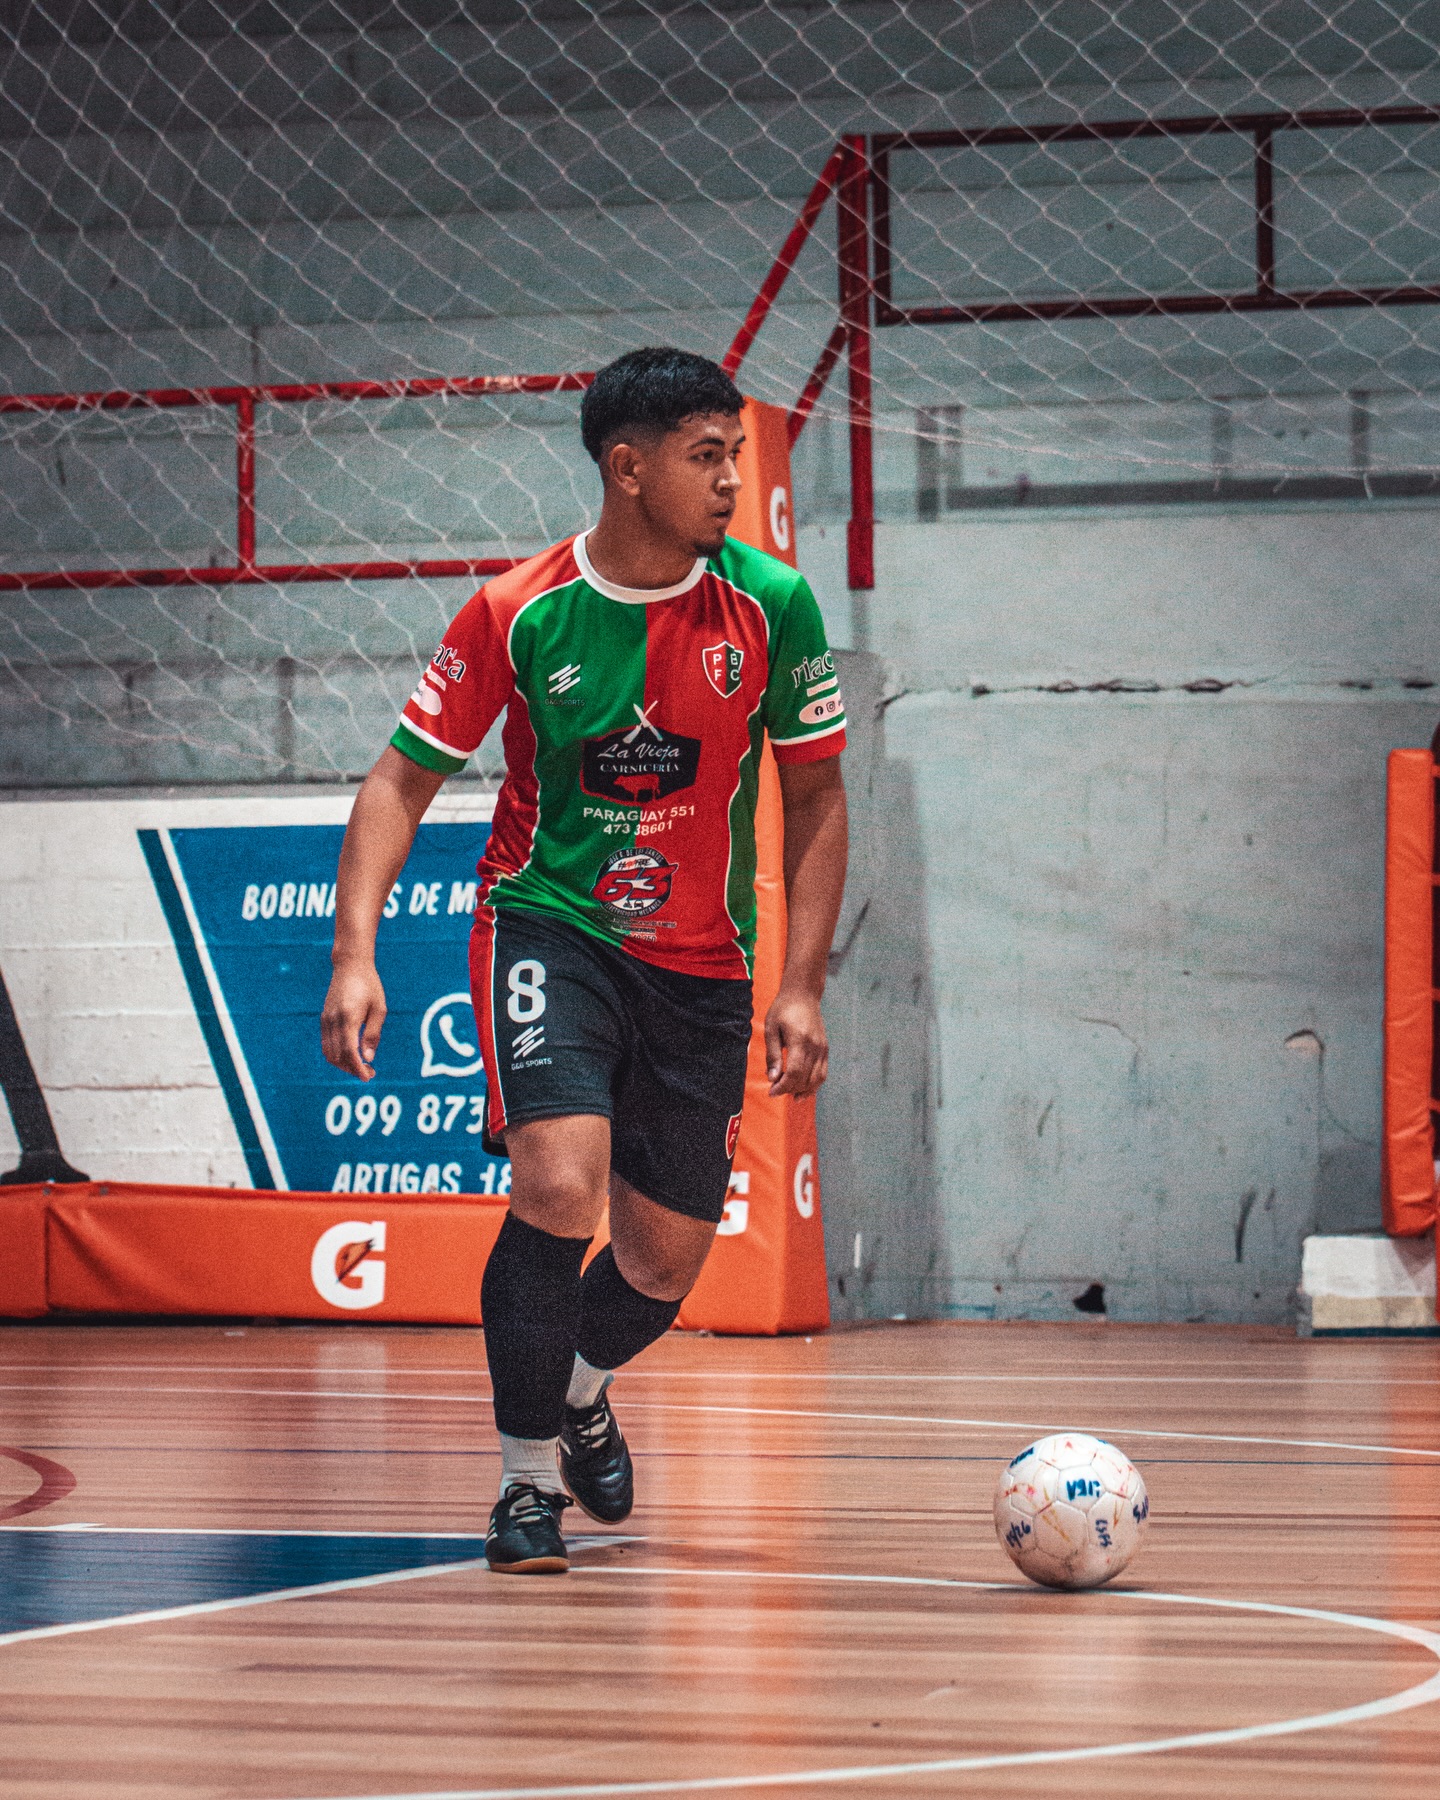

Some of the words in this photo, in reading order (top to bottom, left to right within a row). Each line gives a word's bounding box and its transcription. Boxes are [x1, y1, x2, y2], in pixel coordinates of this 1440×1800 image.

[769, 486, 789, 552] G
[597, 743, 630, 759] La
[635, 742, 681, 761] Vieja
[600, 762, 680, 774] CARNICERÍA
[583, 807, 667, 822] PARAGUAY
[669, 805, 695, 818] 551
[603, 823, 631, 835] 473
[633, 820, 673, 836] 38601
[408, 882, 443, 916] DE
[592, 863, 678, 902] 63
[507, 959, 547, 1024] 8
[525, 1057, 553, 1068] SPORTS
[325, 1094, 402, 1137] 099
[331, 1161, 463, 1195] ARTIGAS
[794, 1154, 814, 1219] G
[311, 1220, 387, 1310] G
